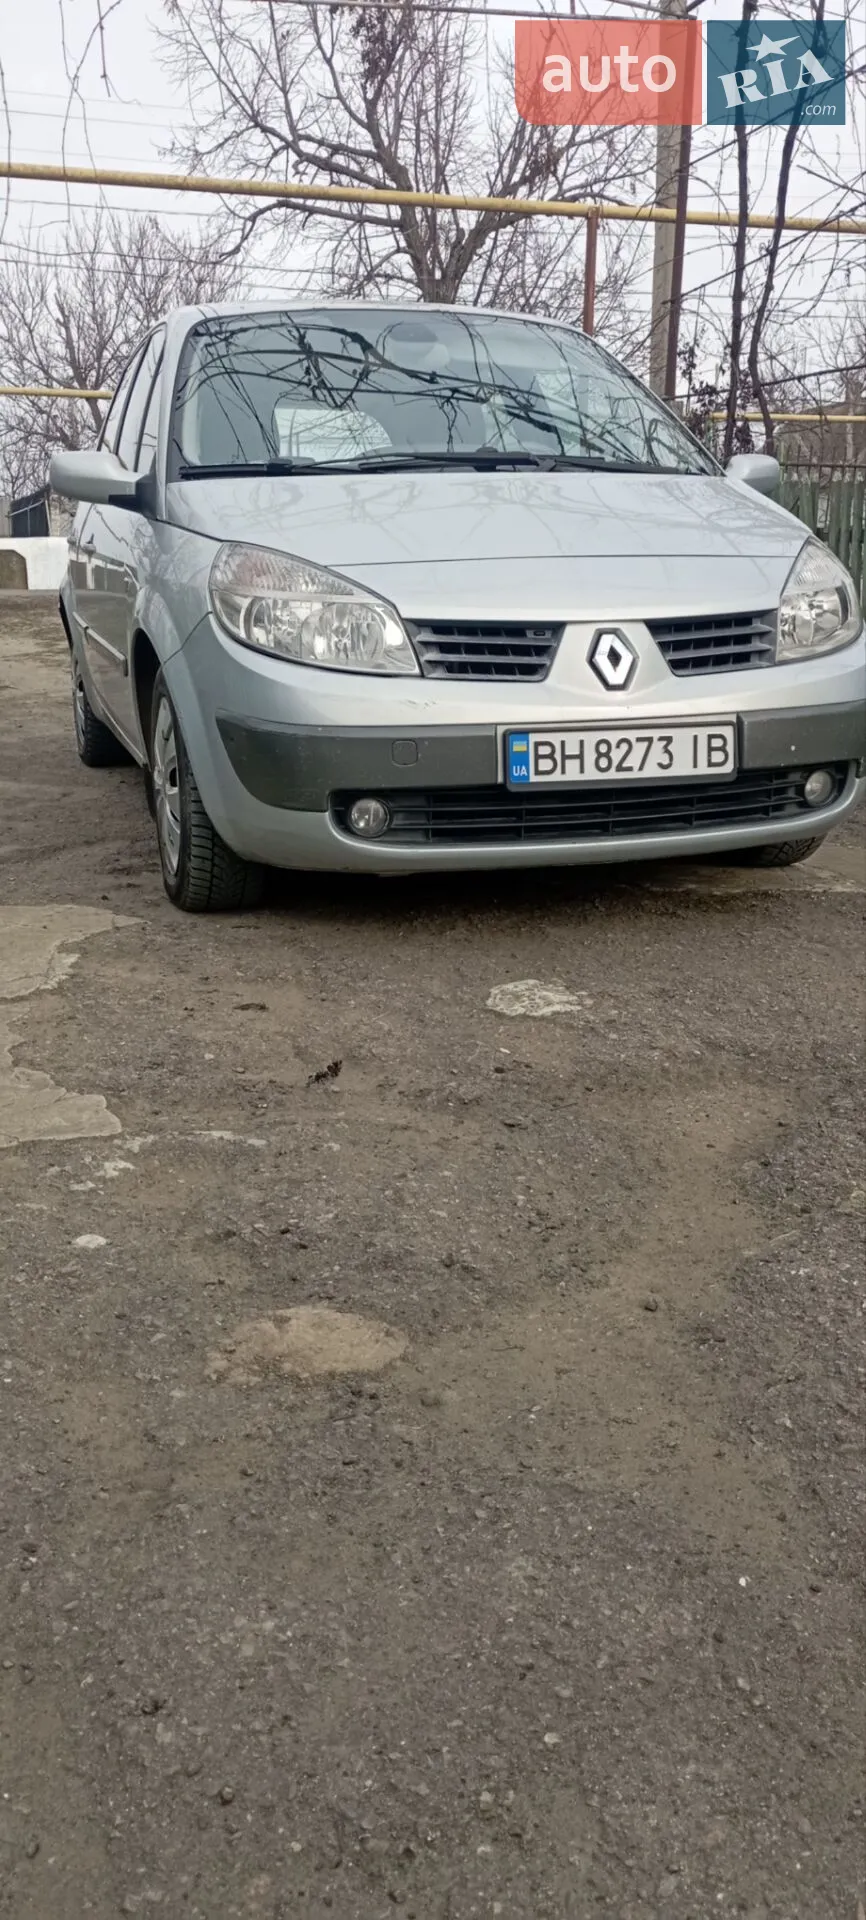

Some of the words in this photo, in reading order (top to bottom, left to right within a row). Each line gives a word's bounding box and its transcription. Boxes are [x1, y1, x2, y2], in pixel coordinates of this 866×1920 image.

[533, 739, 585, 776] BH
[594, 735, 674, 773] 8273
[692, 733, 729, 769] IB
[512, 765, 528, 777] UA
